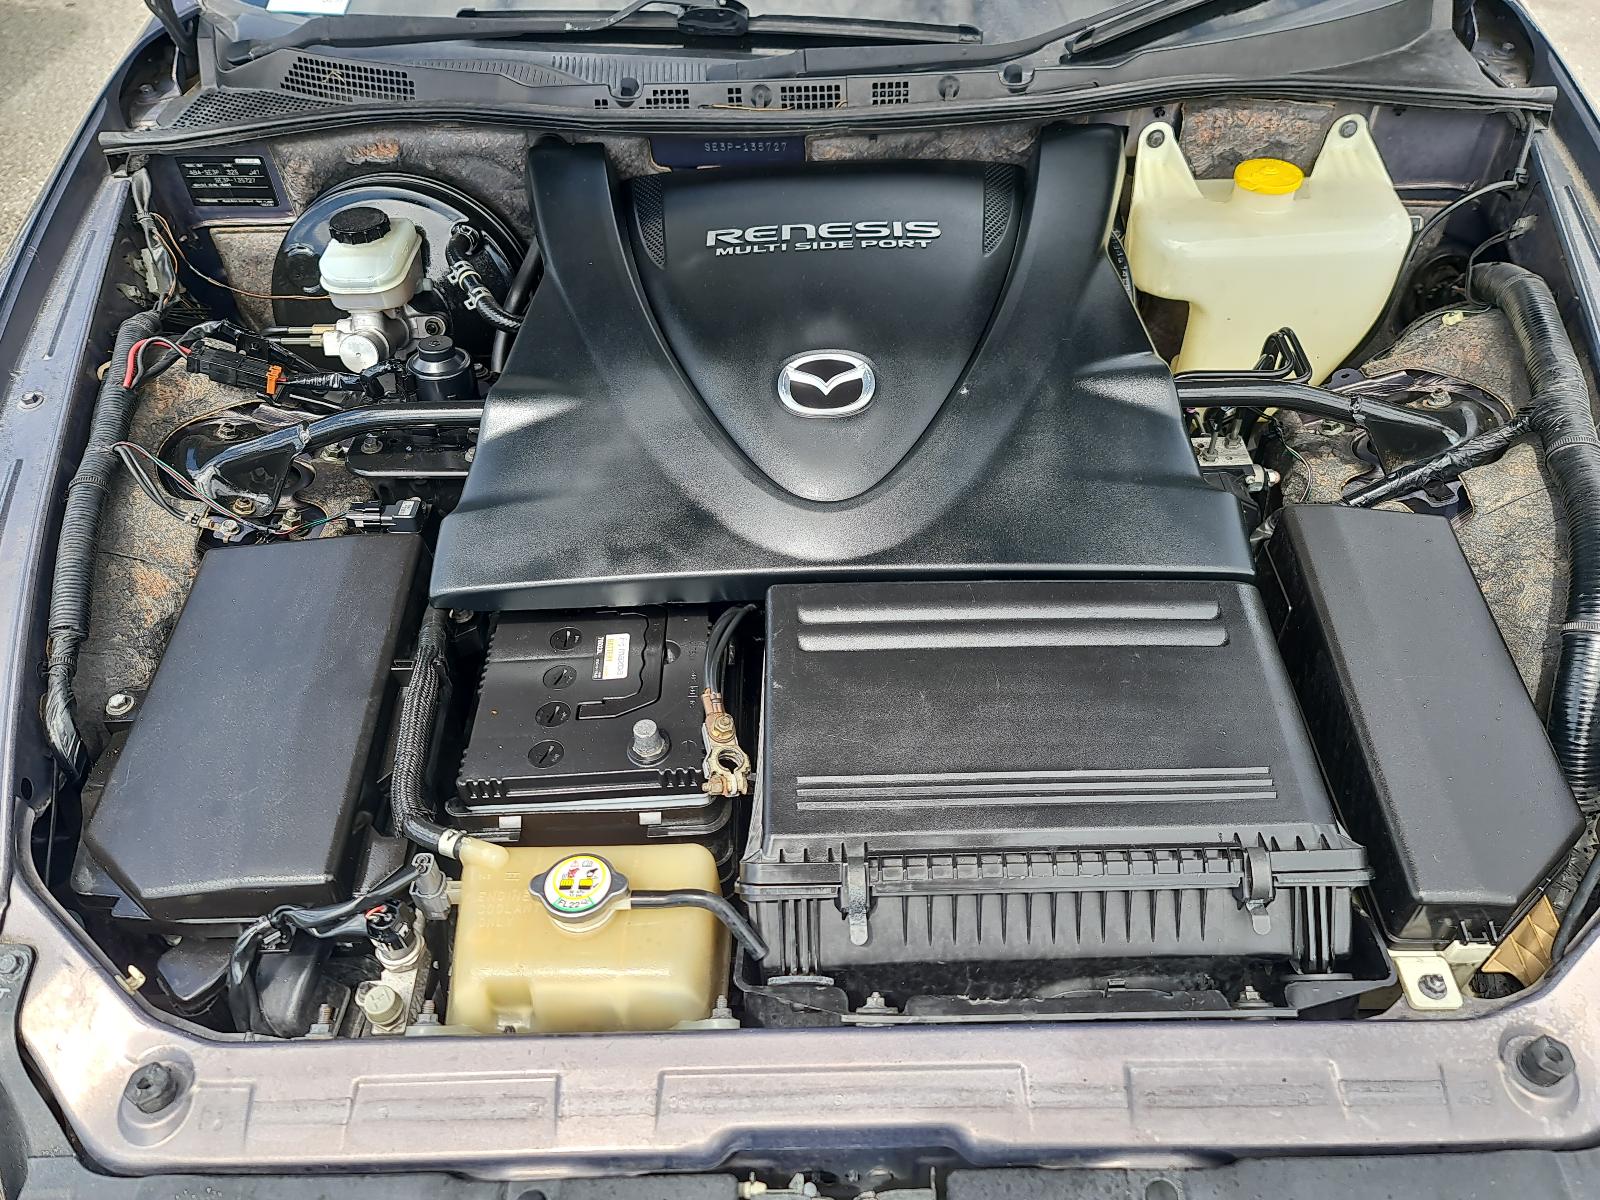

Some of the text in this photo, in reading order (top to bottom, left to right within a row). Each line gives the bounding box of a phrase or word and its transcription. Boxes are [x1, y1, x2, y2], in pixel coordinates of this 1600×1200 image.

[704, 142, 787, 152] SE3P-135727
[706, 221, 943, 247] RENESIS
[715, 239, 932, 256] MULTI SIDE PORT
